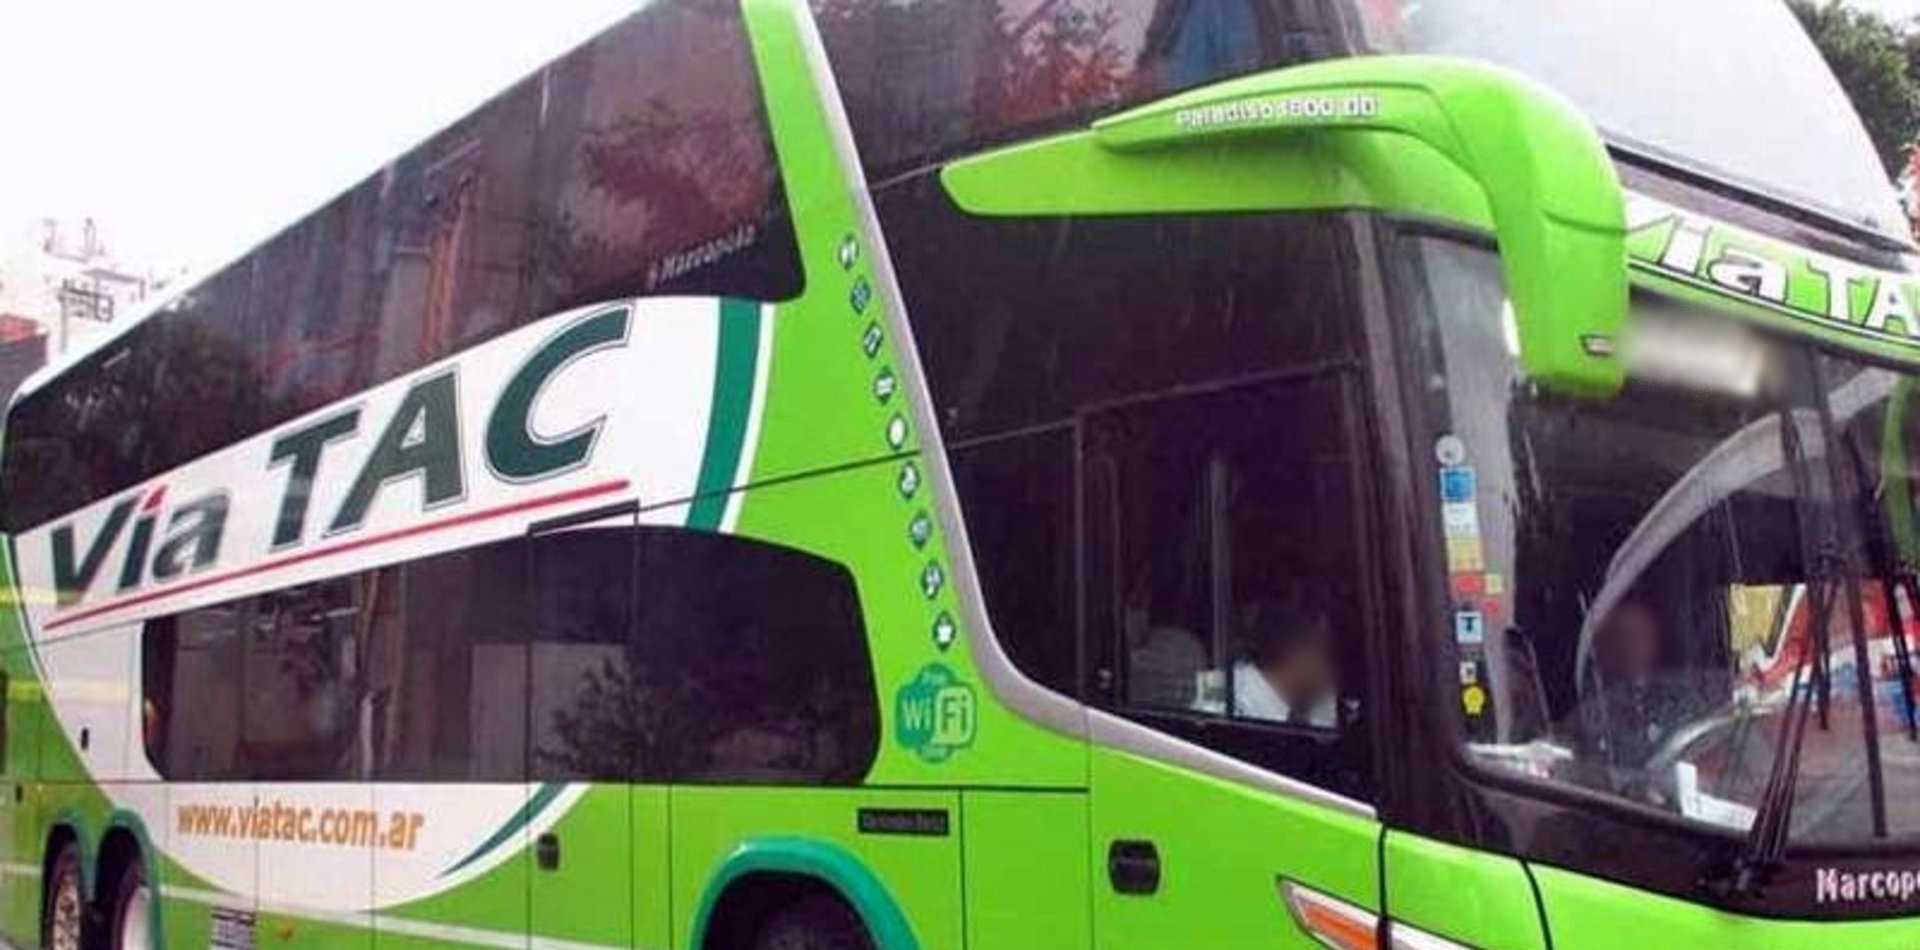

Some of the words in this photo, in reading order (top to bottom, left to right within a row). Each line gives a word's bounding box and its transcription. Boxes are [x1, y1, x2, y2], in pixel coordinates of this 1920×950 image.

[50, 484, 230, 608] Via
[266, 302, 634, 552] TAC
[177, 797, 426, 850] www.viatac.com.ar
